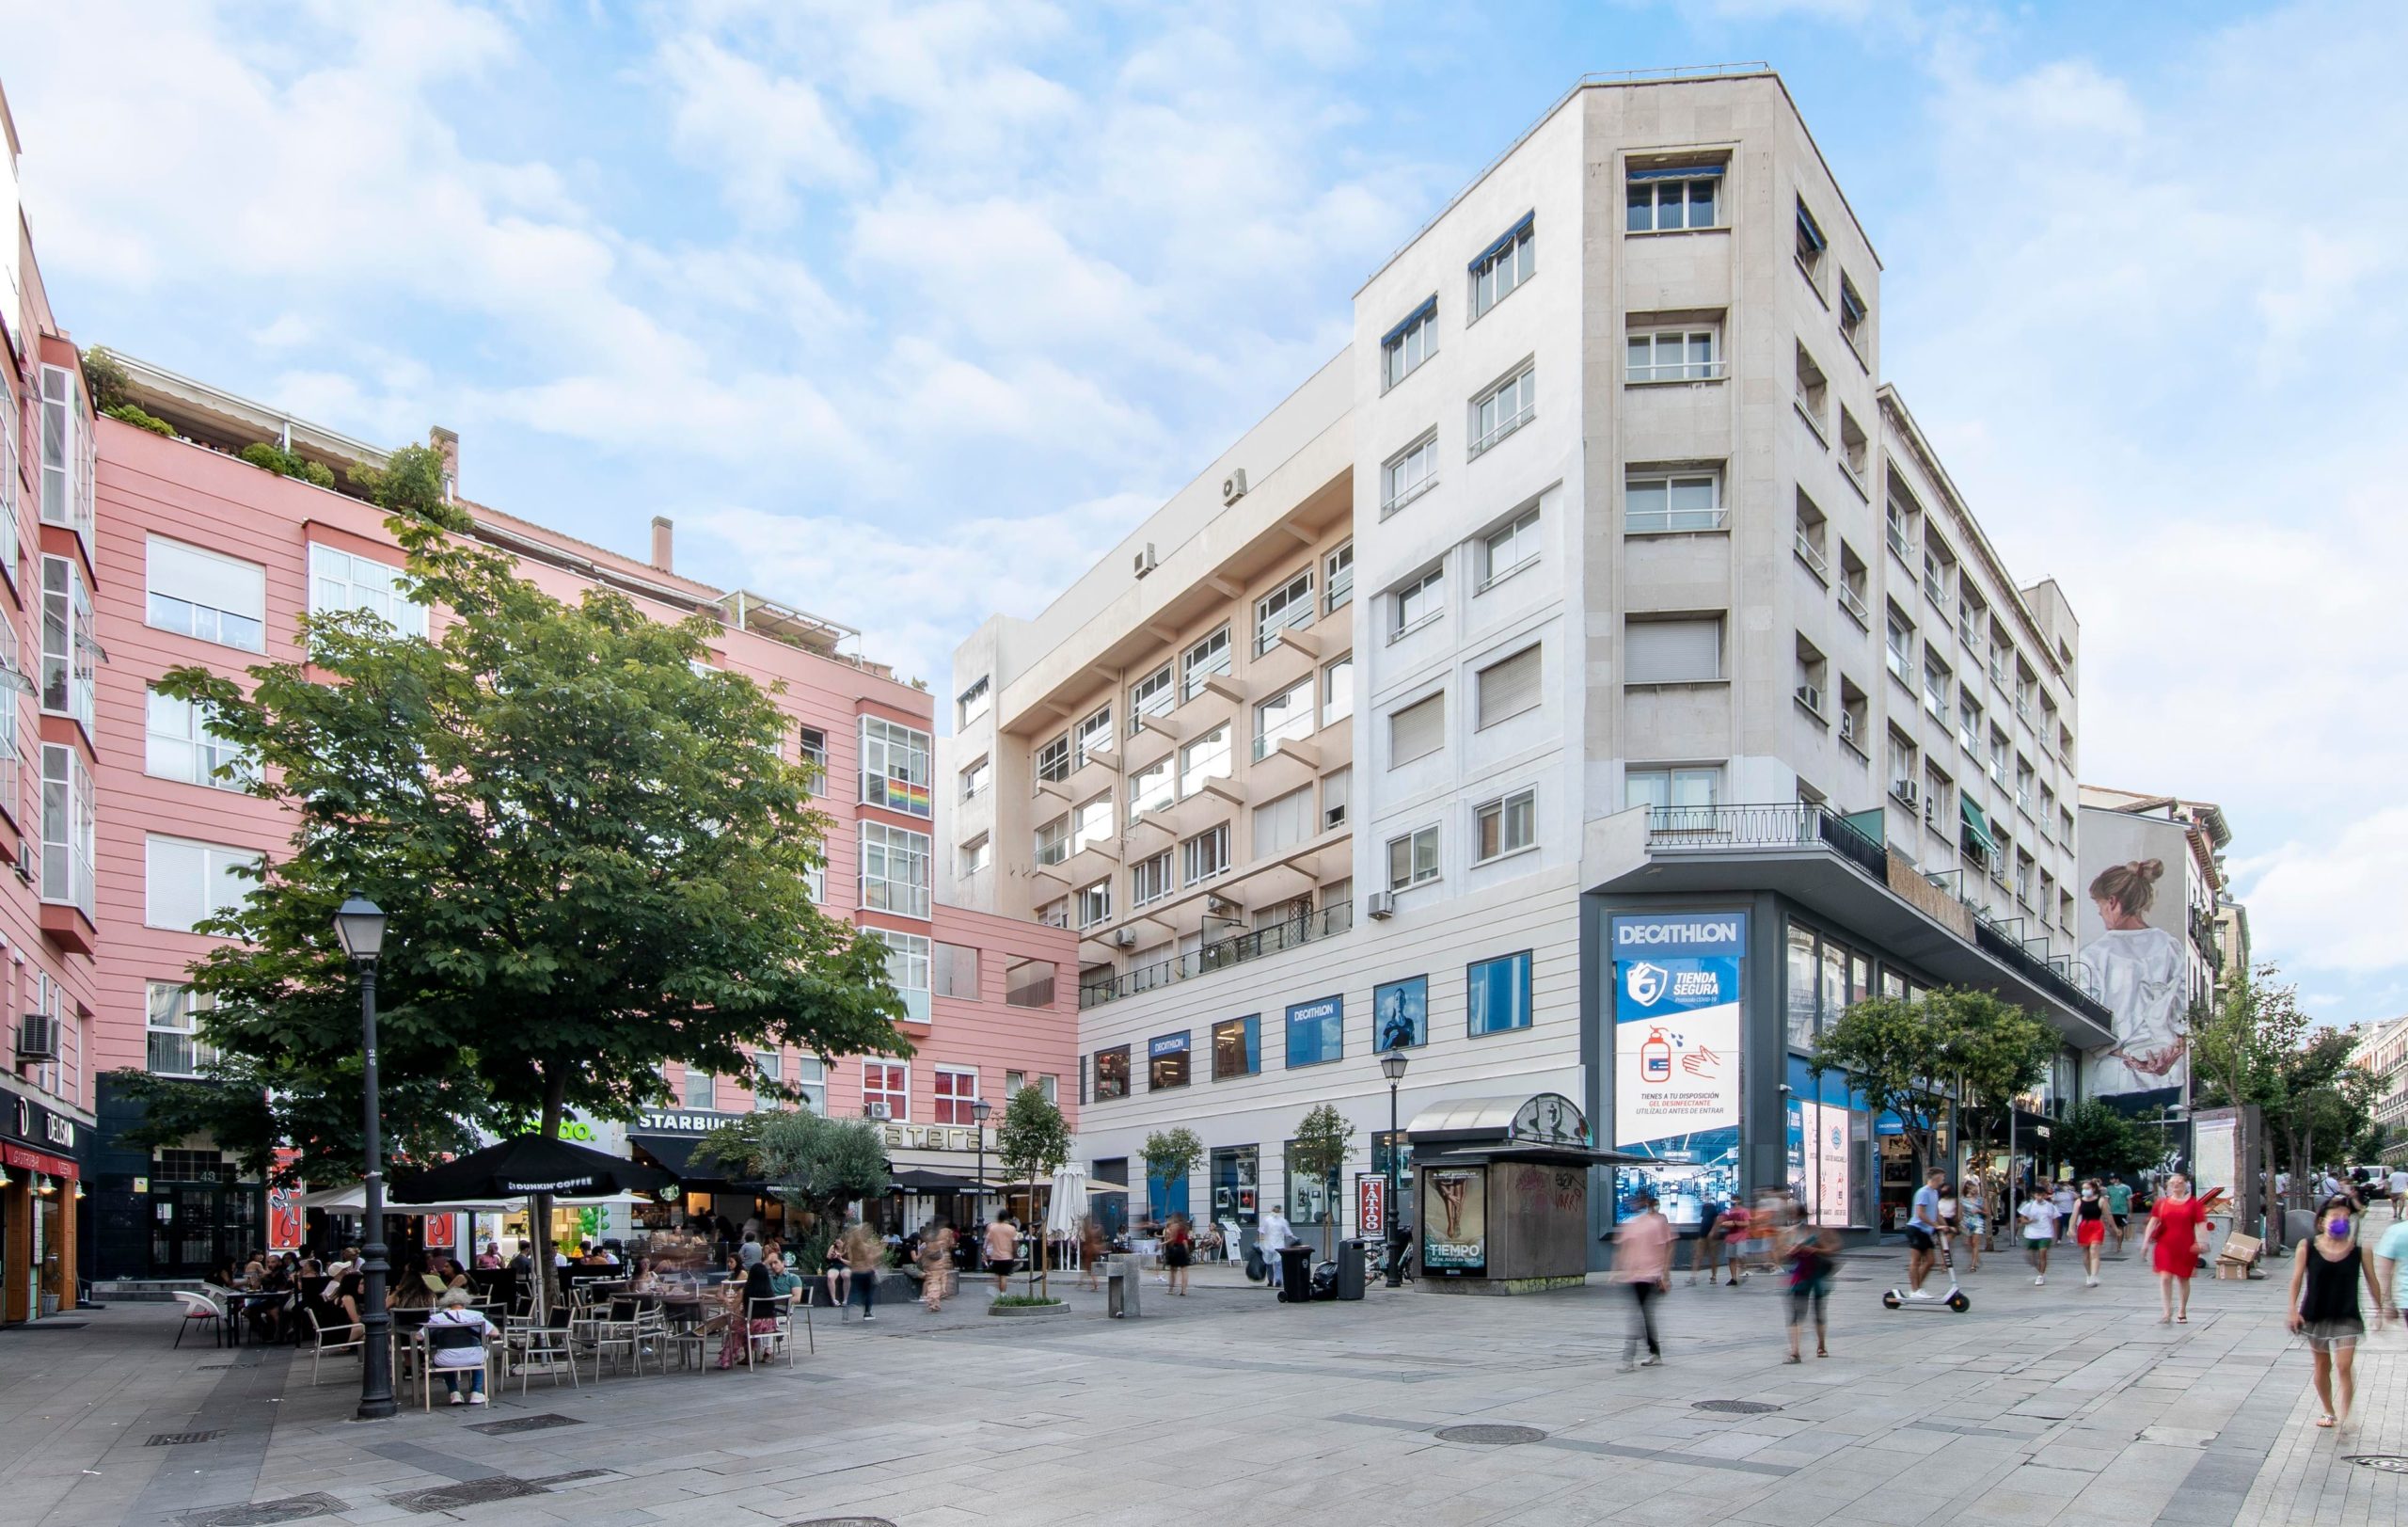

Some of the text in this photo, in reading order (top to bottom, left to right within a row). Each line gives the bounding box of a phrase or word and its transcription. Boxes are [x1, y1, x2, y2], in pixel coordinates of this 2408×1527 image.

[1619, 923, 1736, 945] DECATHLON
[1676, 971, 1716, 984] TIENDA
[1672, 982, 1719, 995] SEGURA
[1294, 1003, 1334, 1022] DECATHLON
[1154, 1037, 1184, 1053] DECATHLON
[200, 1171, 215, 1182] 43
[516, 1176, 593, 1190] DUNKIN' COFFEE
[1365, 1182, 1379, 1230] TATTOO
[1429, 1244, 1480, 1257] TIEMPO
